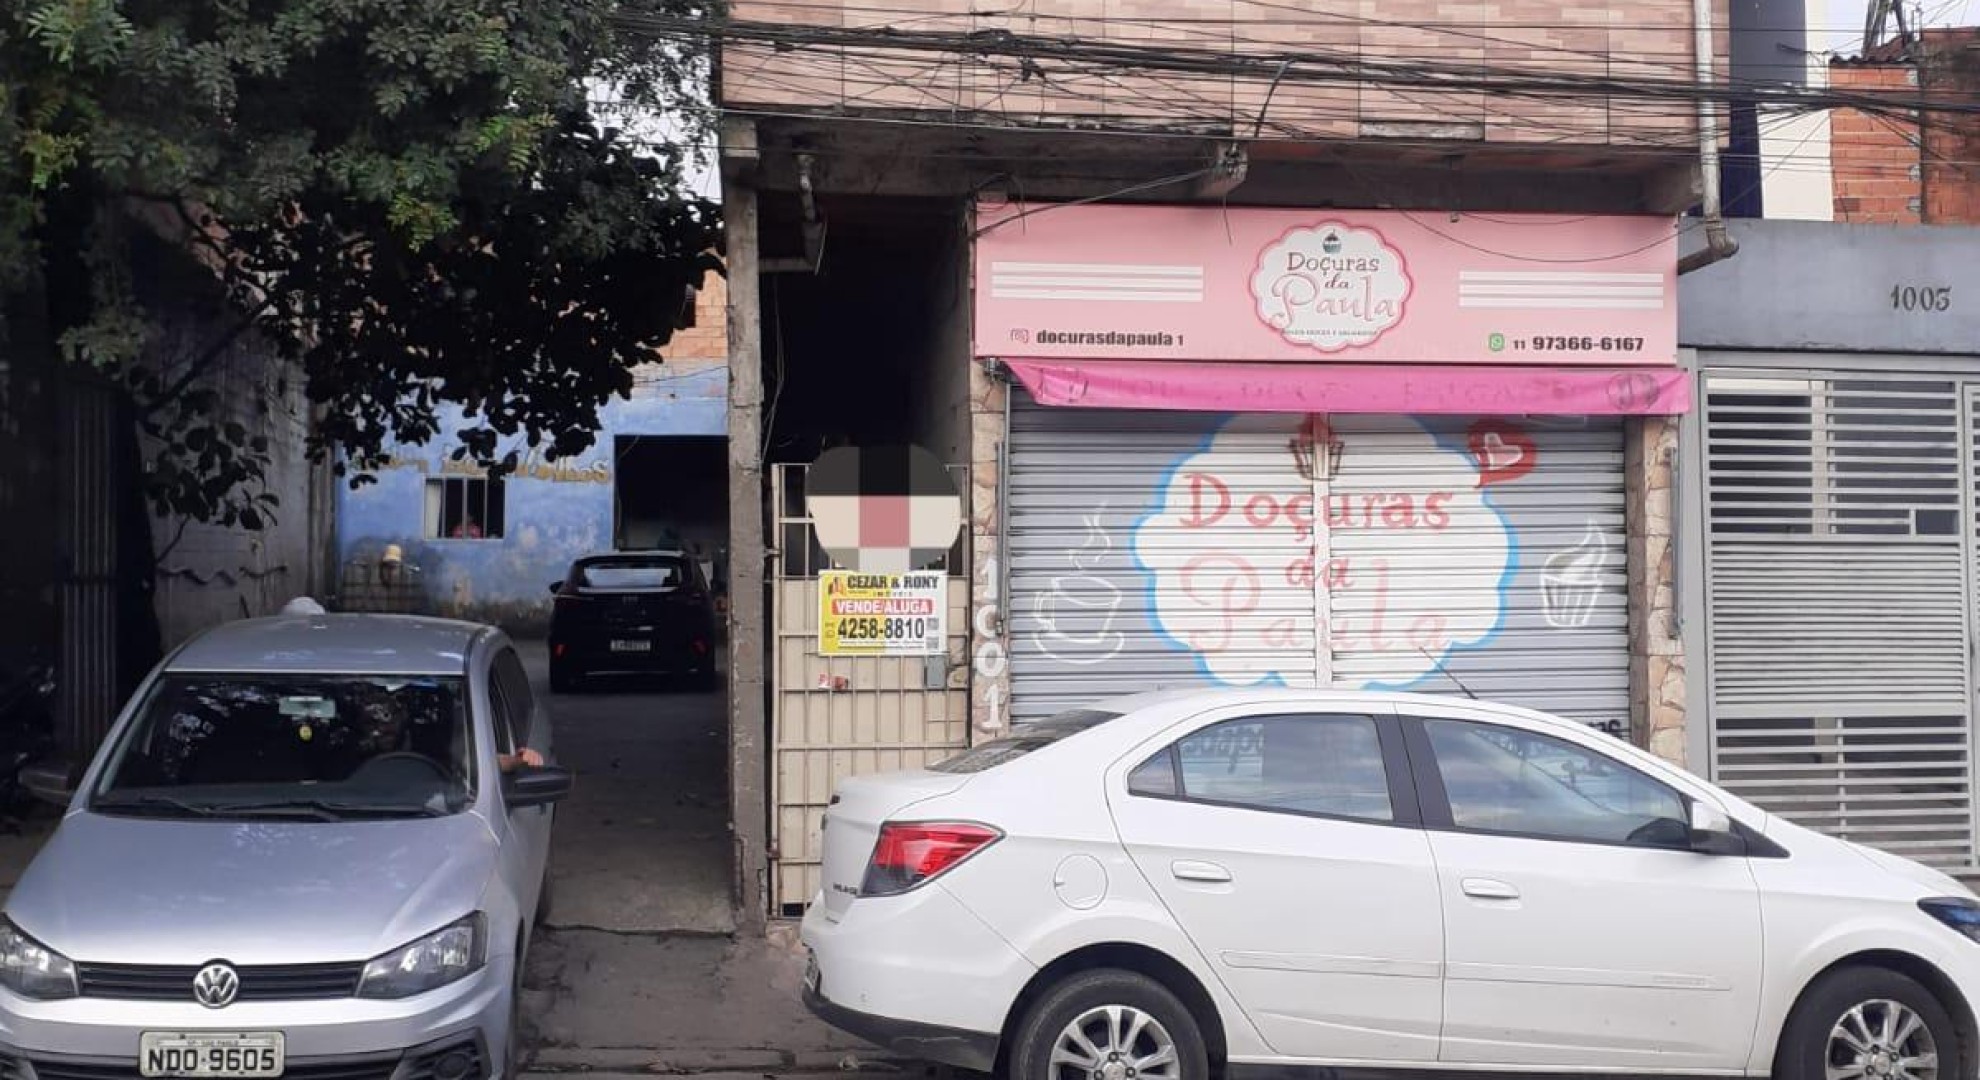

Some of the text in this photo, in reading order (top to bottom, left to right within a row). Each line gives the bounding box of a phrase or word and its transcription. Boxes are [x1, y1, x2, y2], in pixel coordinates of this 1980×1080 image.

[1287, 251, 1380, 276] Doçuras
[1324, 273, 1350, 290] da
[1270, 273, 1396, 329] Paula
[1889, 284, 1953, 313] 1005
[1036, 329, 1174, 347] docurasdapaula
[1513, 335, 1645, 351] 11 97366-6167
[1179, 473, 1454, 542] Doçuras
[1284, 545, 1355, 589] da
[847, 575, 888, 589] CEZAR
[903, 576, 939, 589] RONY
[1178, 551, 1450, 655] Paula
[837, 617, 925, 639] 4258-8810
